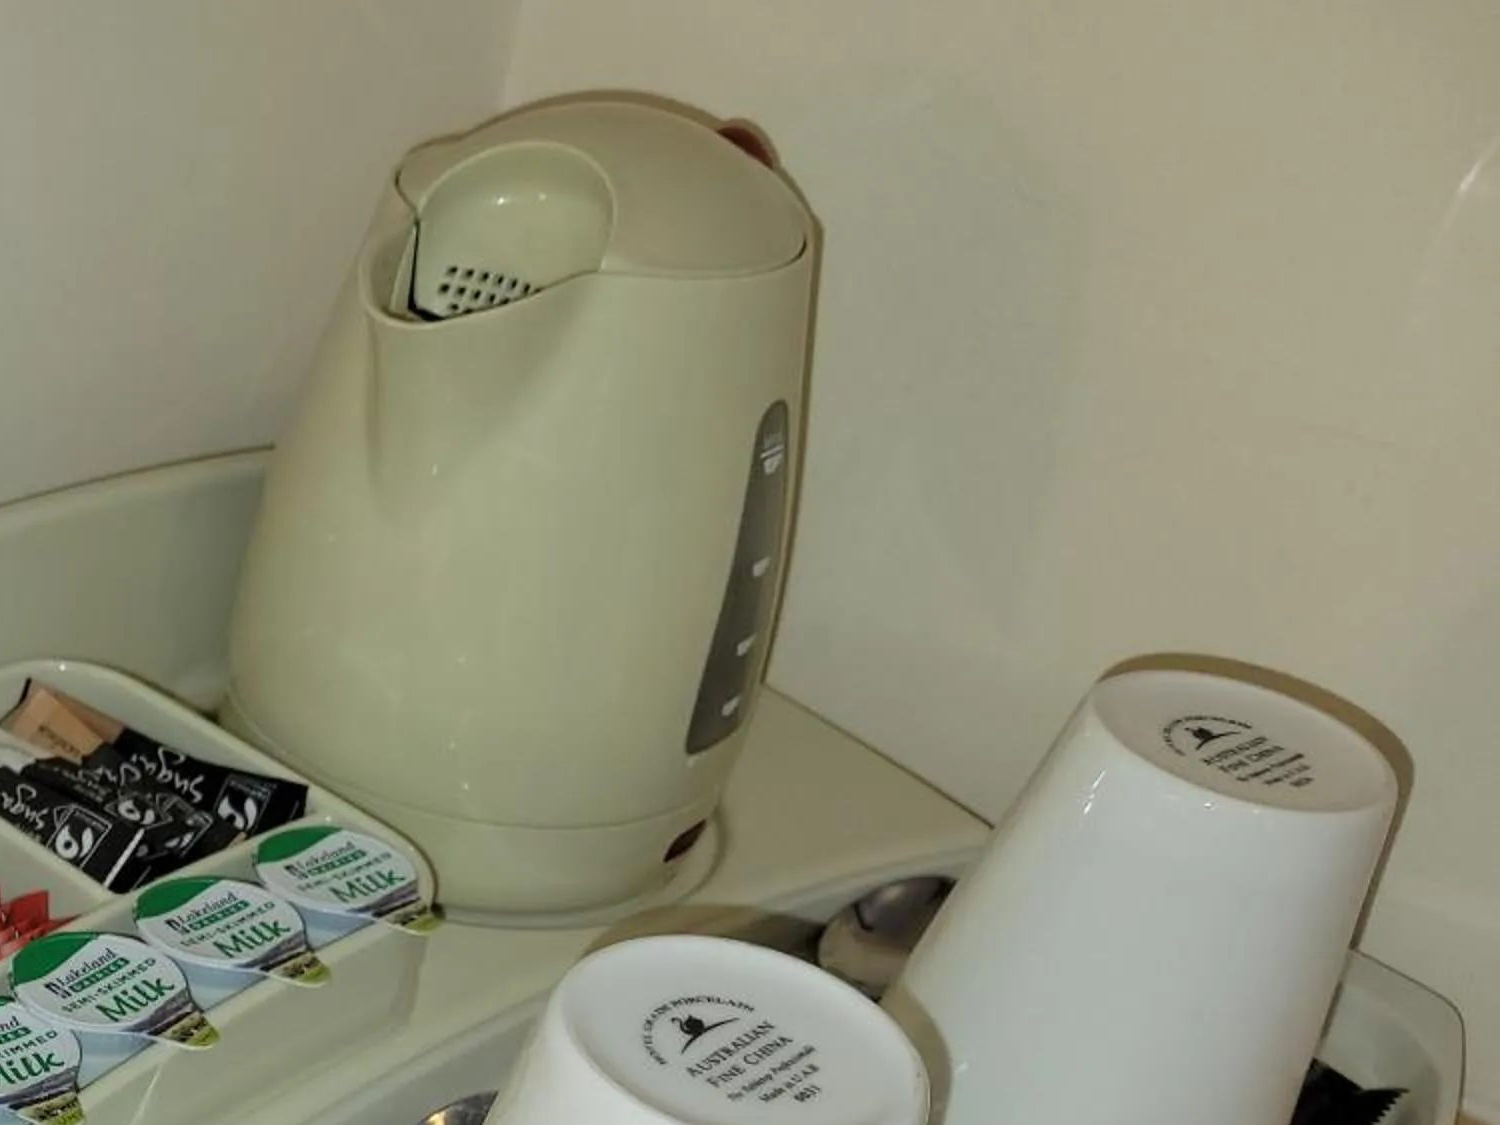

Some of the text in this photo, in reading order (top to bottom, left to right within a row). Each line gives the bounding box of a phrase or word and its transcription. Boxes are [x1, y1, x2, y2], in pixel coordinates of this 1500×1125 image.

[329, 870, 406, 903] Milk
[213, 920, 291, 958] Milk
[96, 978, 175, 1022] Milk
[686, 1020, 776, 1078] AUSTRALIAN
[706, 1066, 746, 1089] FINE
[743, 1036, 794, 1066] CHINA
